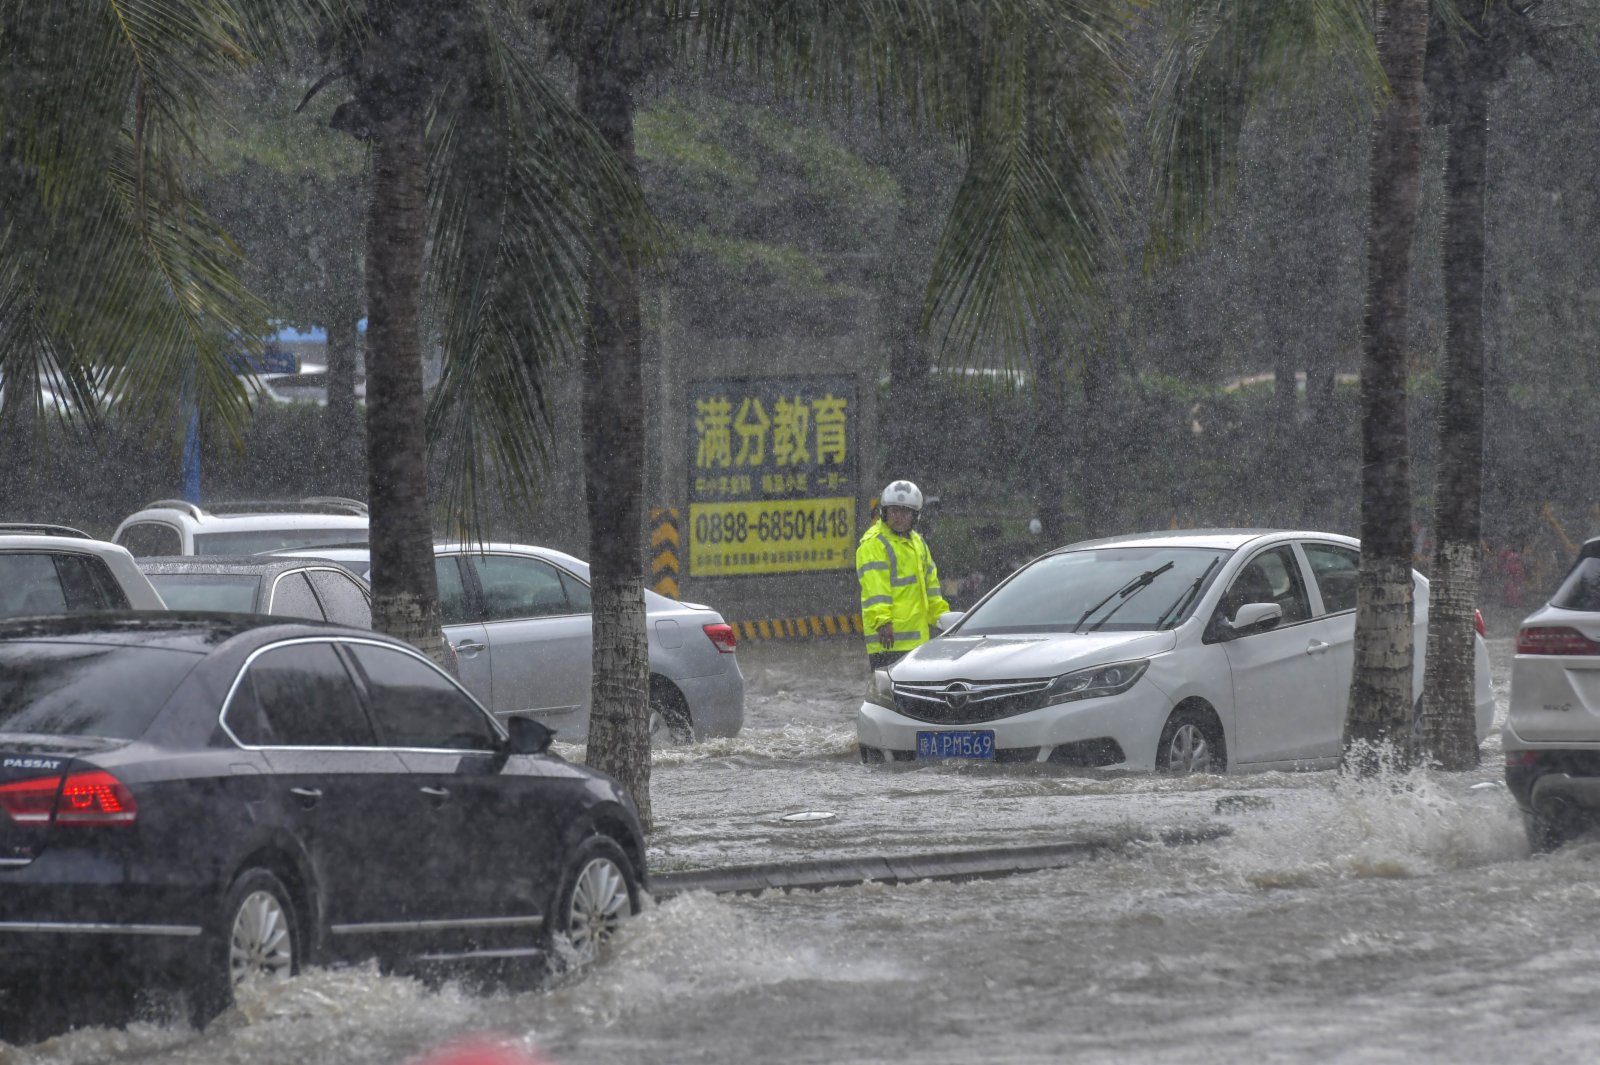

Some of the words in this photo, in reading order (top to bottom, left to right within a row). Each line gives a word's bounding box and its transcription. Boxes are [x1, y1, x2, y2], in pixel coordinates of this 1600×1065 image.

[695, 393, 849, 469] 满分教育
[695, 507, 849, 544] 0898-68501418
[3, 758, 61, 769] PASSAT
